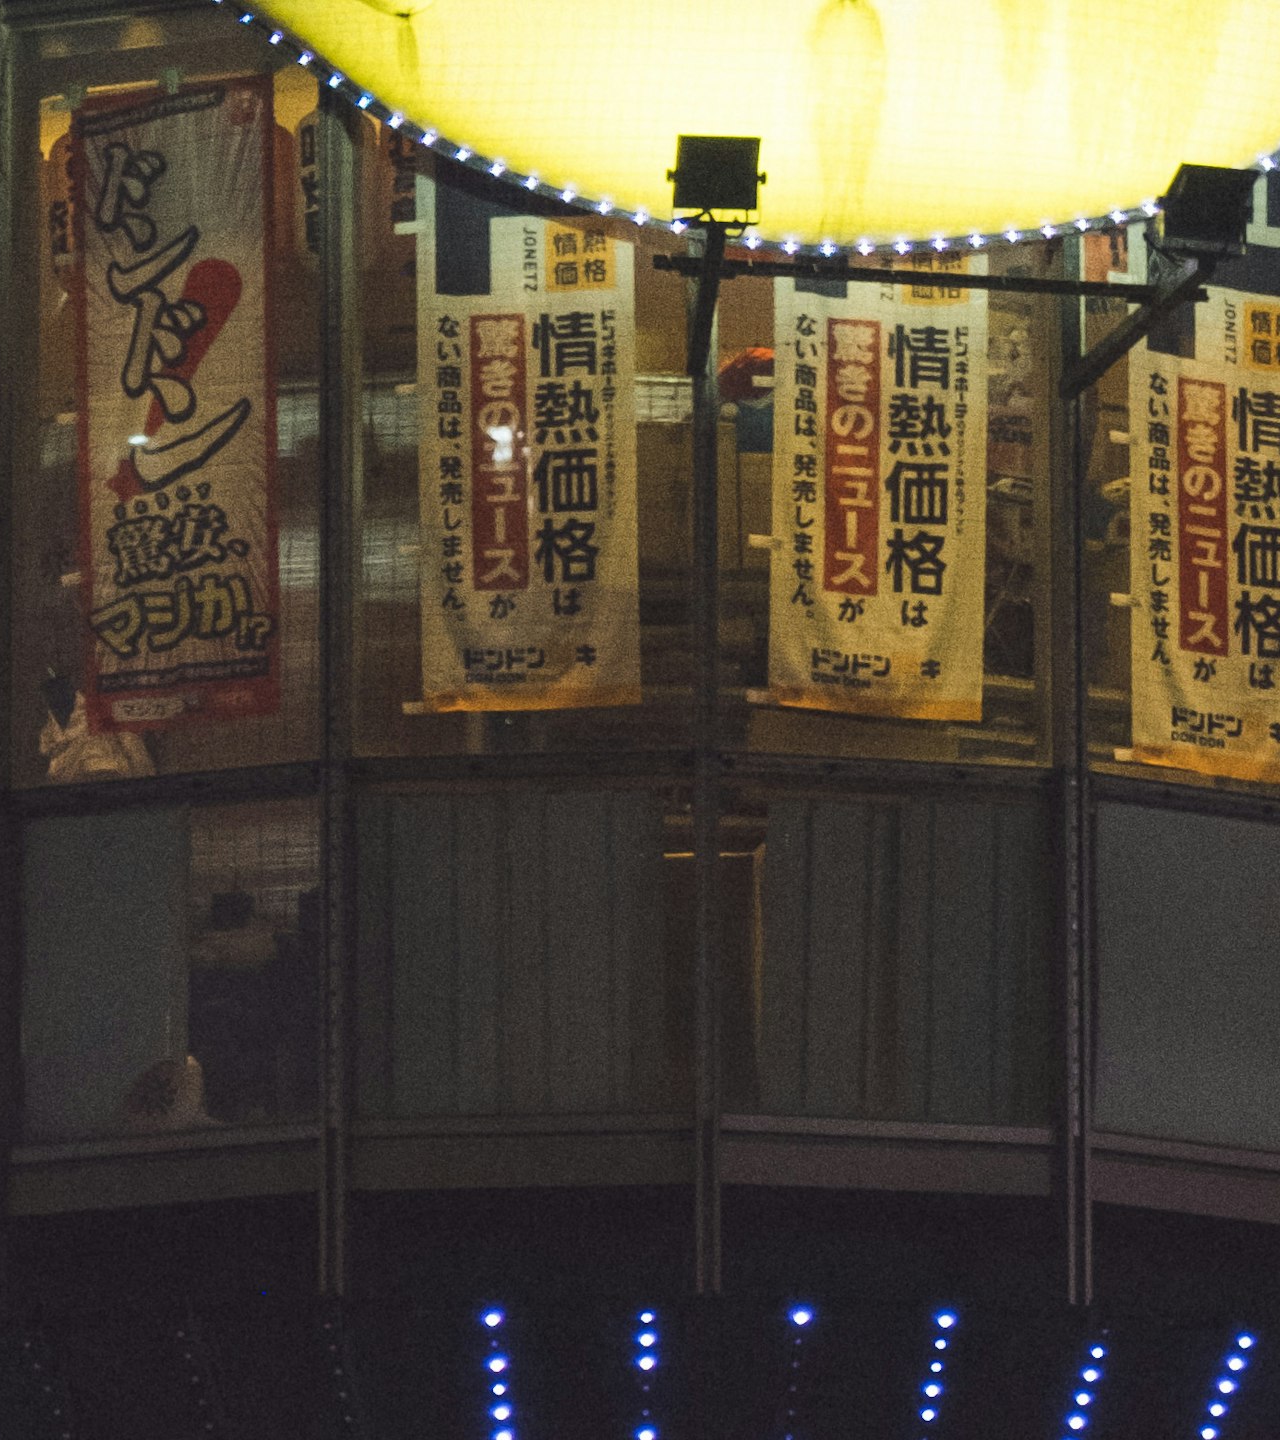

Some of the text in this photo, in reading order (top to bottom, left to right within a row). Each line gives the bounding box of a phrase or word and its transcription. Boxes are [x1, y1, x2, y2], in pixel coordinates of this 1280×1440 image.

[523, 227, 538, 293] JONETZ
[1223, 299, 1237, 365] JONETZ
[532, 311, 600, 617] 情熱価格は
[830, 323, 877, 624] 驚きのニュースが
[885, 324, 952, 629] 情熱価格は
[462, 645, 547, 672] ドンドン
[810, 648, 890, 677] ドンドン
[1171, 706, 1243, 738] ドンドン
